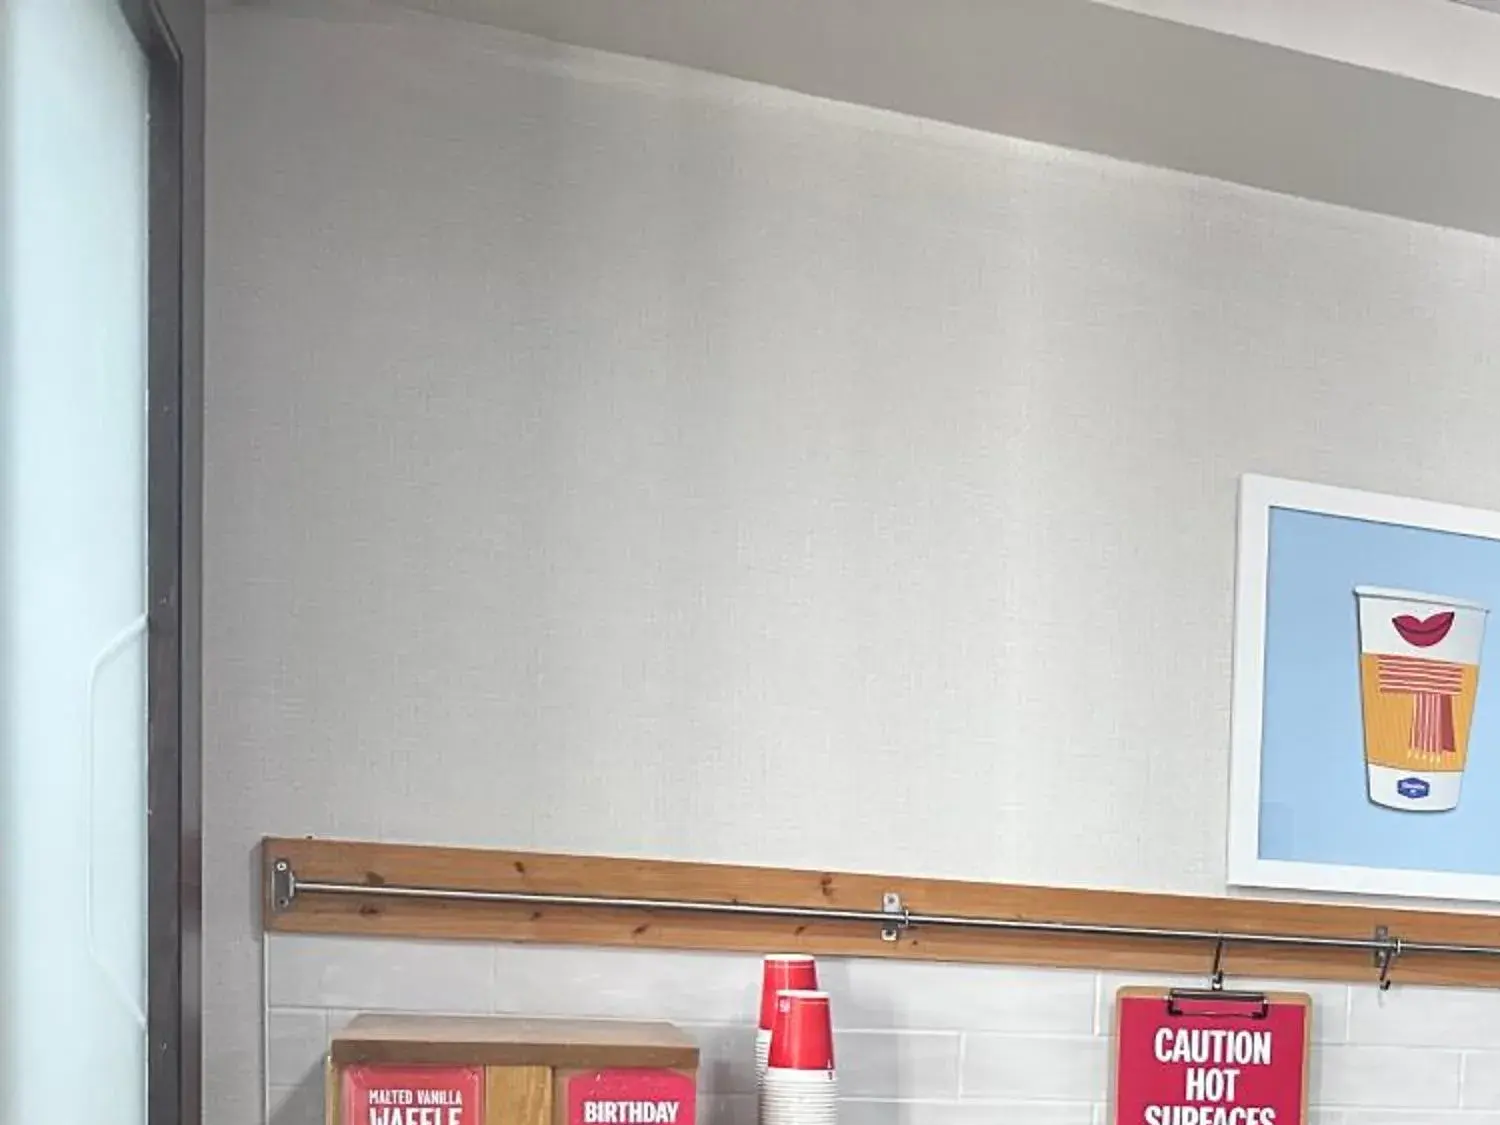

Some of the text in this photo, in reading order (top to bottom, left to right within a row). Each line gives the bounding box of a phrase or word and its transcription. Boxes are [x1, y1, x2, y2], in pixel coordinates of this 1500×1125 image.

[1154, 1027, 1271, 1065] CAUTION
[368, 1089, 463, 1106] MALTED VANILLA
[1185, 1067, 1241, 1102] HOT
[584, 1101, 679, 1123] BIRTHDAY
